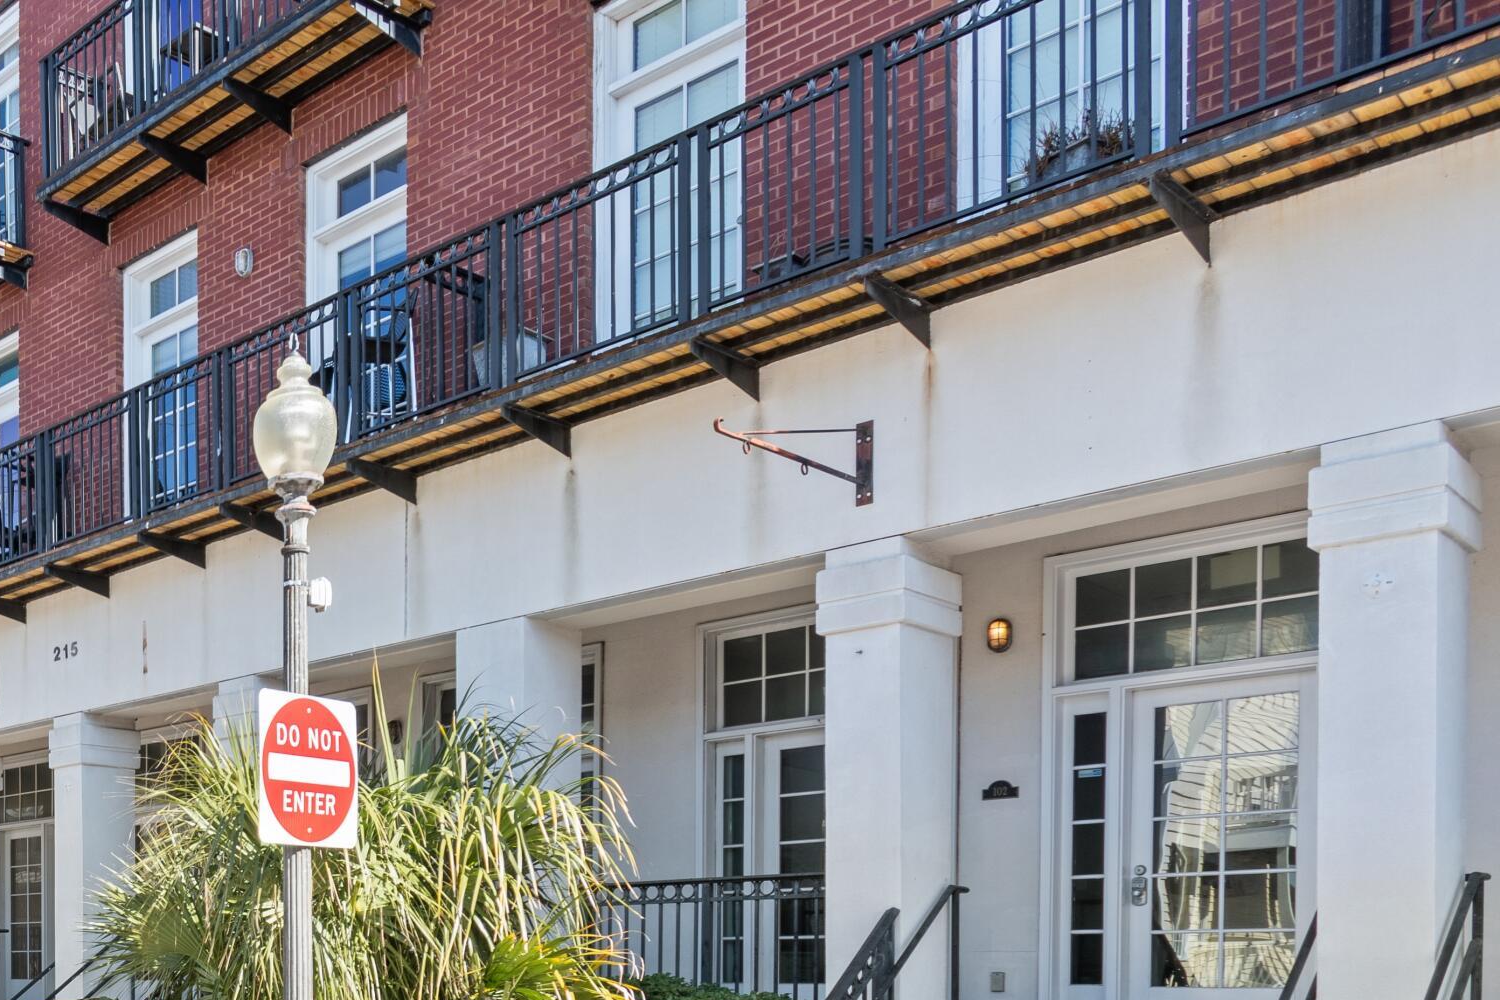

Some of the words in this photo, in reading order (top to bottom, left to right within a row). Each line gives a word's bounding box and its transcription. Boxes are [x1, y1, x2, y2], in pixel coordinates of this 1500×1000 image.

[53, 641, 78, 662] 215
[276, 722, 300, 748] DO
[308, 727, 342, 753] NOT
[282, 789, 336, 816] ENTER
[992, 786, 1008, 797] 102
